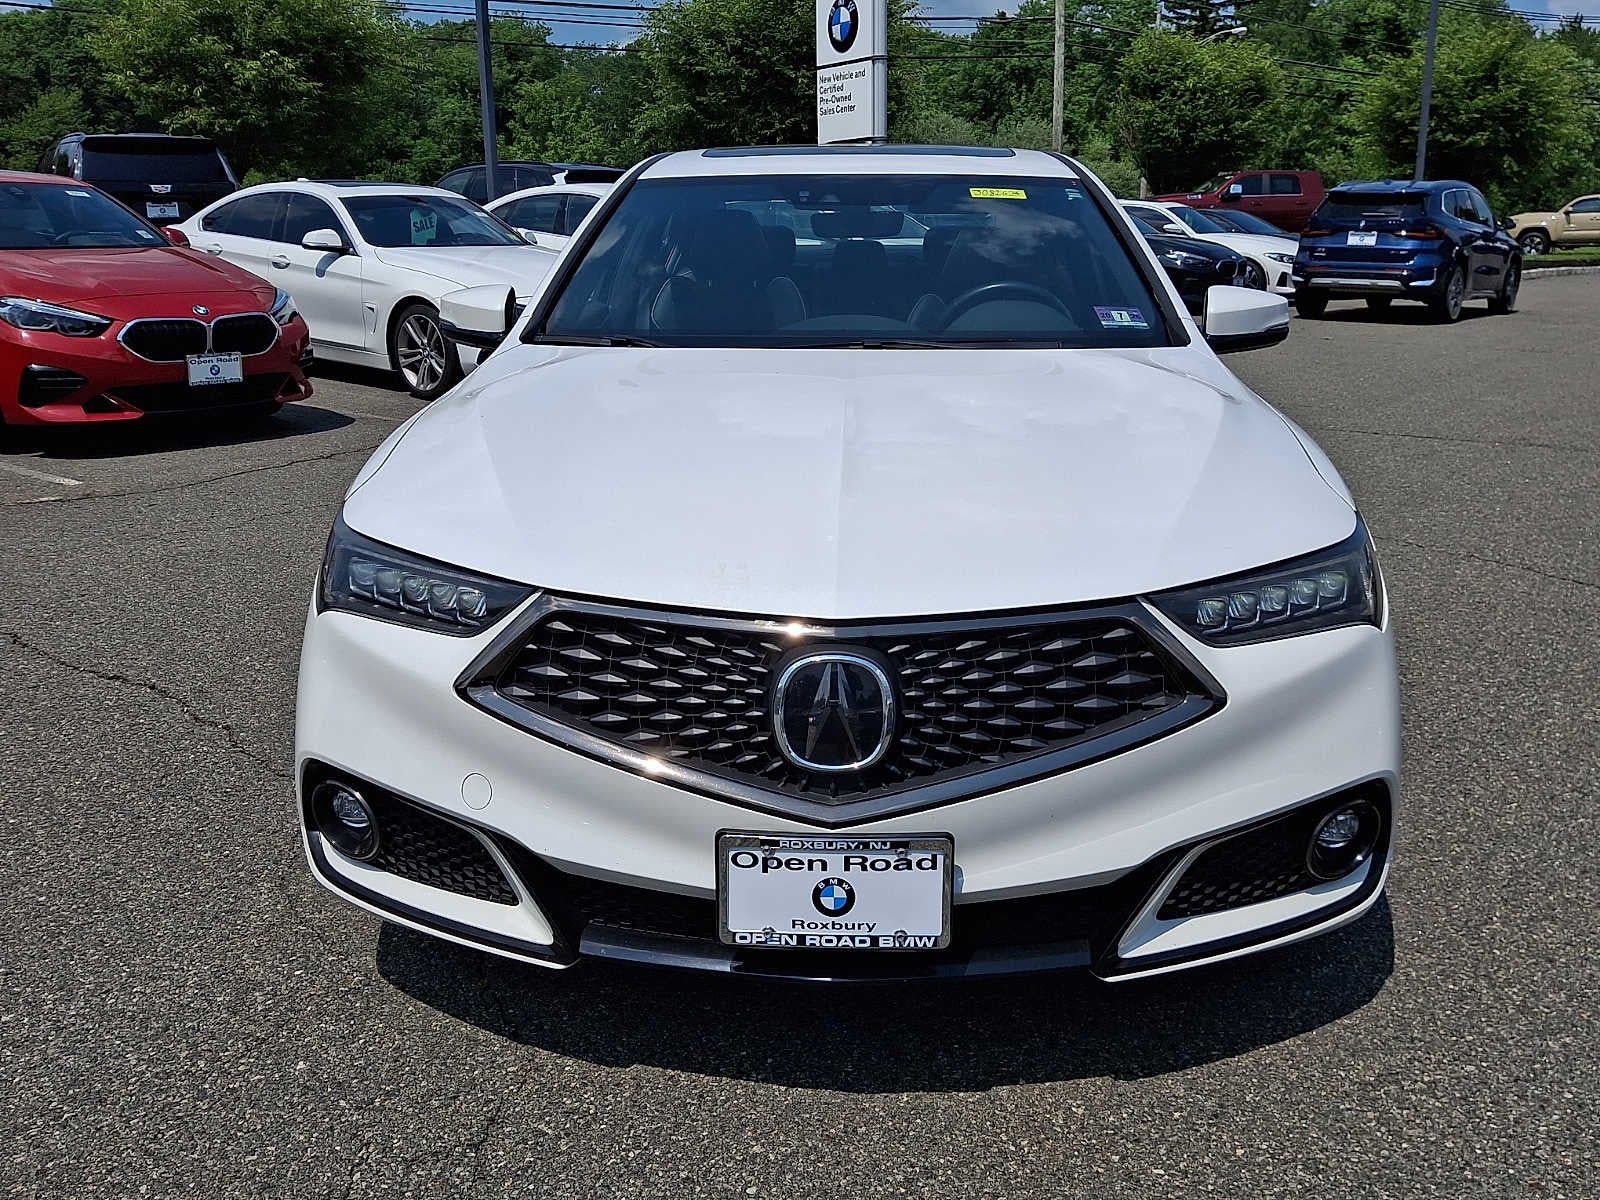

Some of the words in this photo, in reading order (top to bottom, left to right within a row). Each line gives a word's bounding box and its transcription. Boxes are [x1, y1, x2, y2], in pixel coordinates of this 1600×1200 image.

[819, 75, 831, 84] New
[832, 70, 854, 82] Vehicle
[854, 67, 866, 78] and
[819, 83, 844, 95] Certified
[819, 92, 852, 106] Pre-Owned
[819, 106, 835, 117] Sales
[835, 103, 856, 114] Center
[412, 216, 435, 233] SALE
[779, 840, 863, 850] ROXBURY,
[869, 841, 891, 850] NJ
[730, 851, 828, 874] Open
[843, 854, 938, 872] Road
[818, 878, 851, 890] BMW
[791, 919, 877, 932] Roxbury
[735, 932, 797, 946] OPEN
[805, 935, 871, 948] ROAD
[878, 936, 935, 948] BMW
